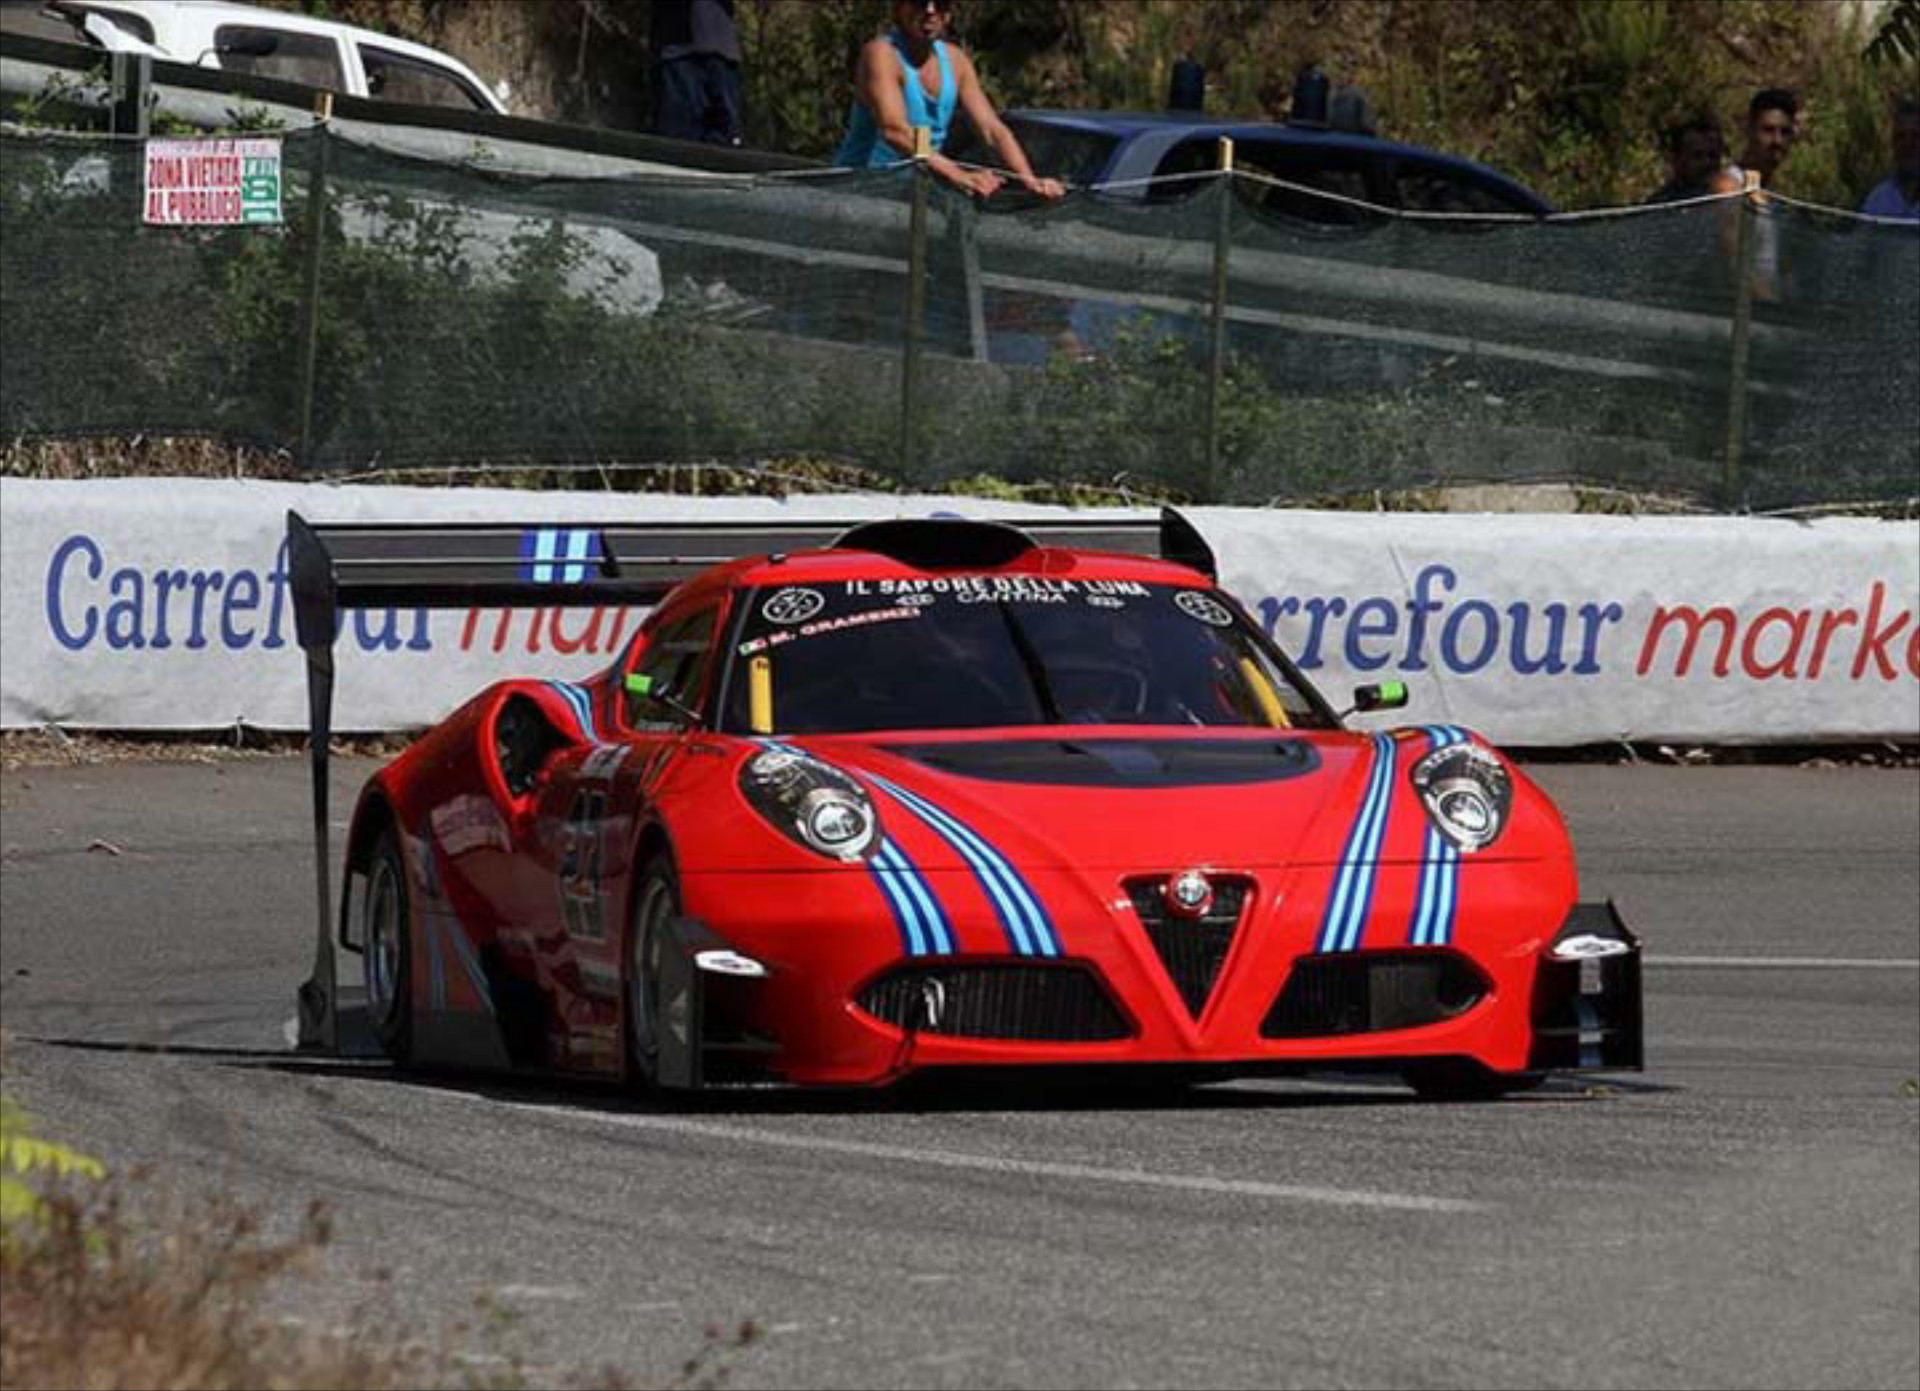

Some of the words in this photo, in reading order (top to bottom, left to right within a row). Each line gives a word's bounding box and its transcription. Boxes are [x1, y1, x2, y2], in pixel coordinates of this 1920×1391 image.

[148, 157, 182, 188] ZONA
[187, 157, 241, 188] VIETATA
[148, 191, 166, 221] AL
[169, 191, 241, 221] PUBBLICO
[846, 579, 871, 596] IL
[879, 575, 987, 595] SAPORE
[993, 576, 1079, 593] DELLA
[1082, 579, 1151, 597] LUNA
[956, 588, 1068, 604] CANTINA
